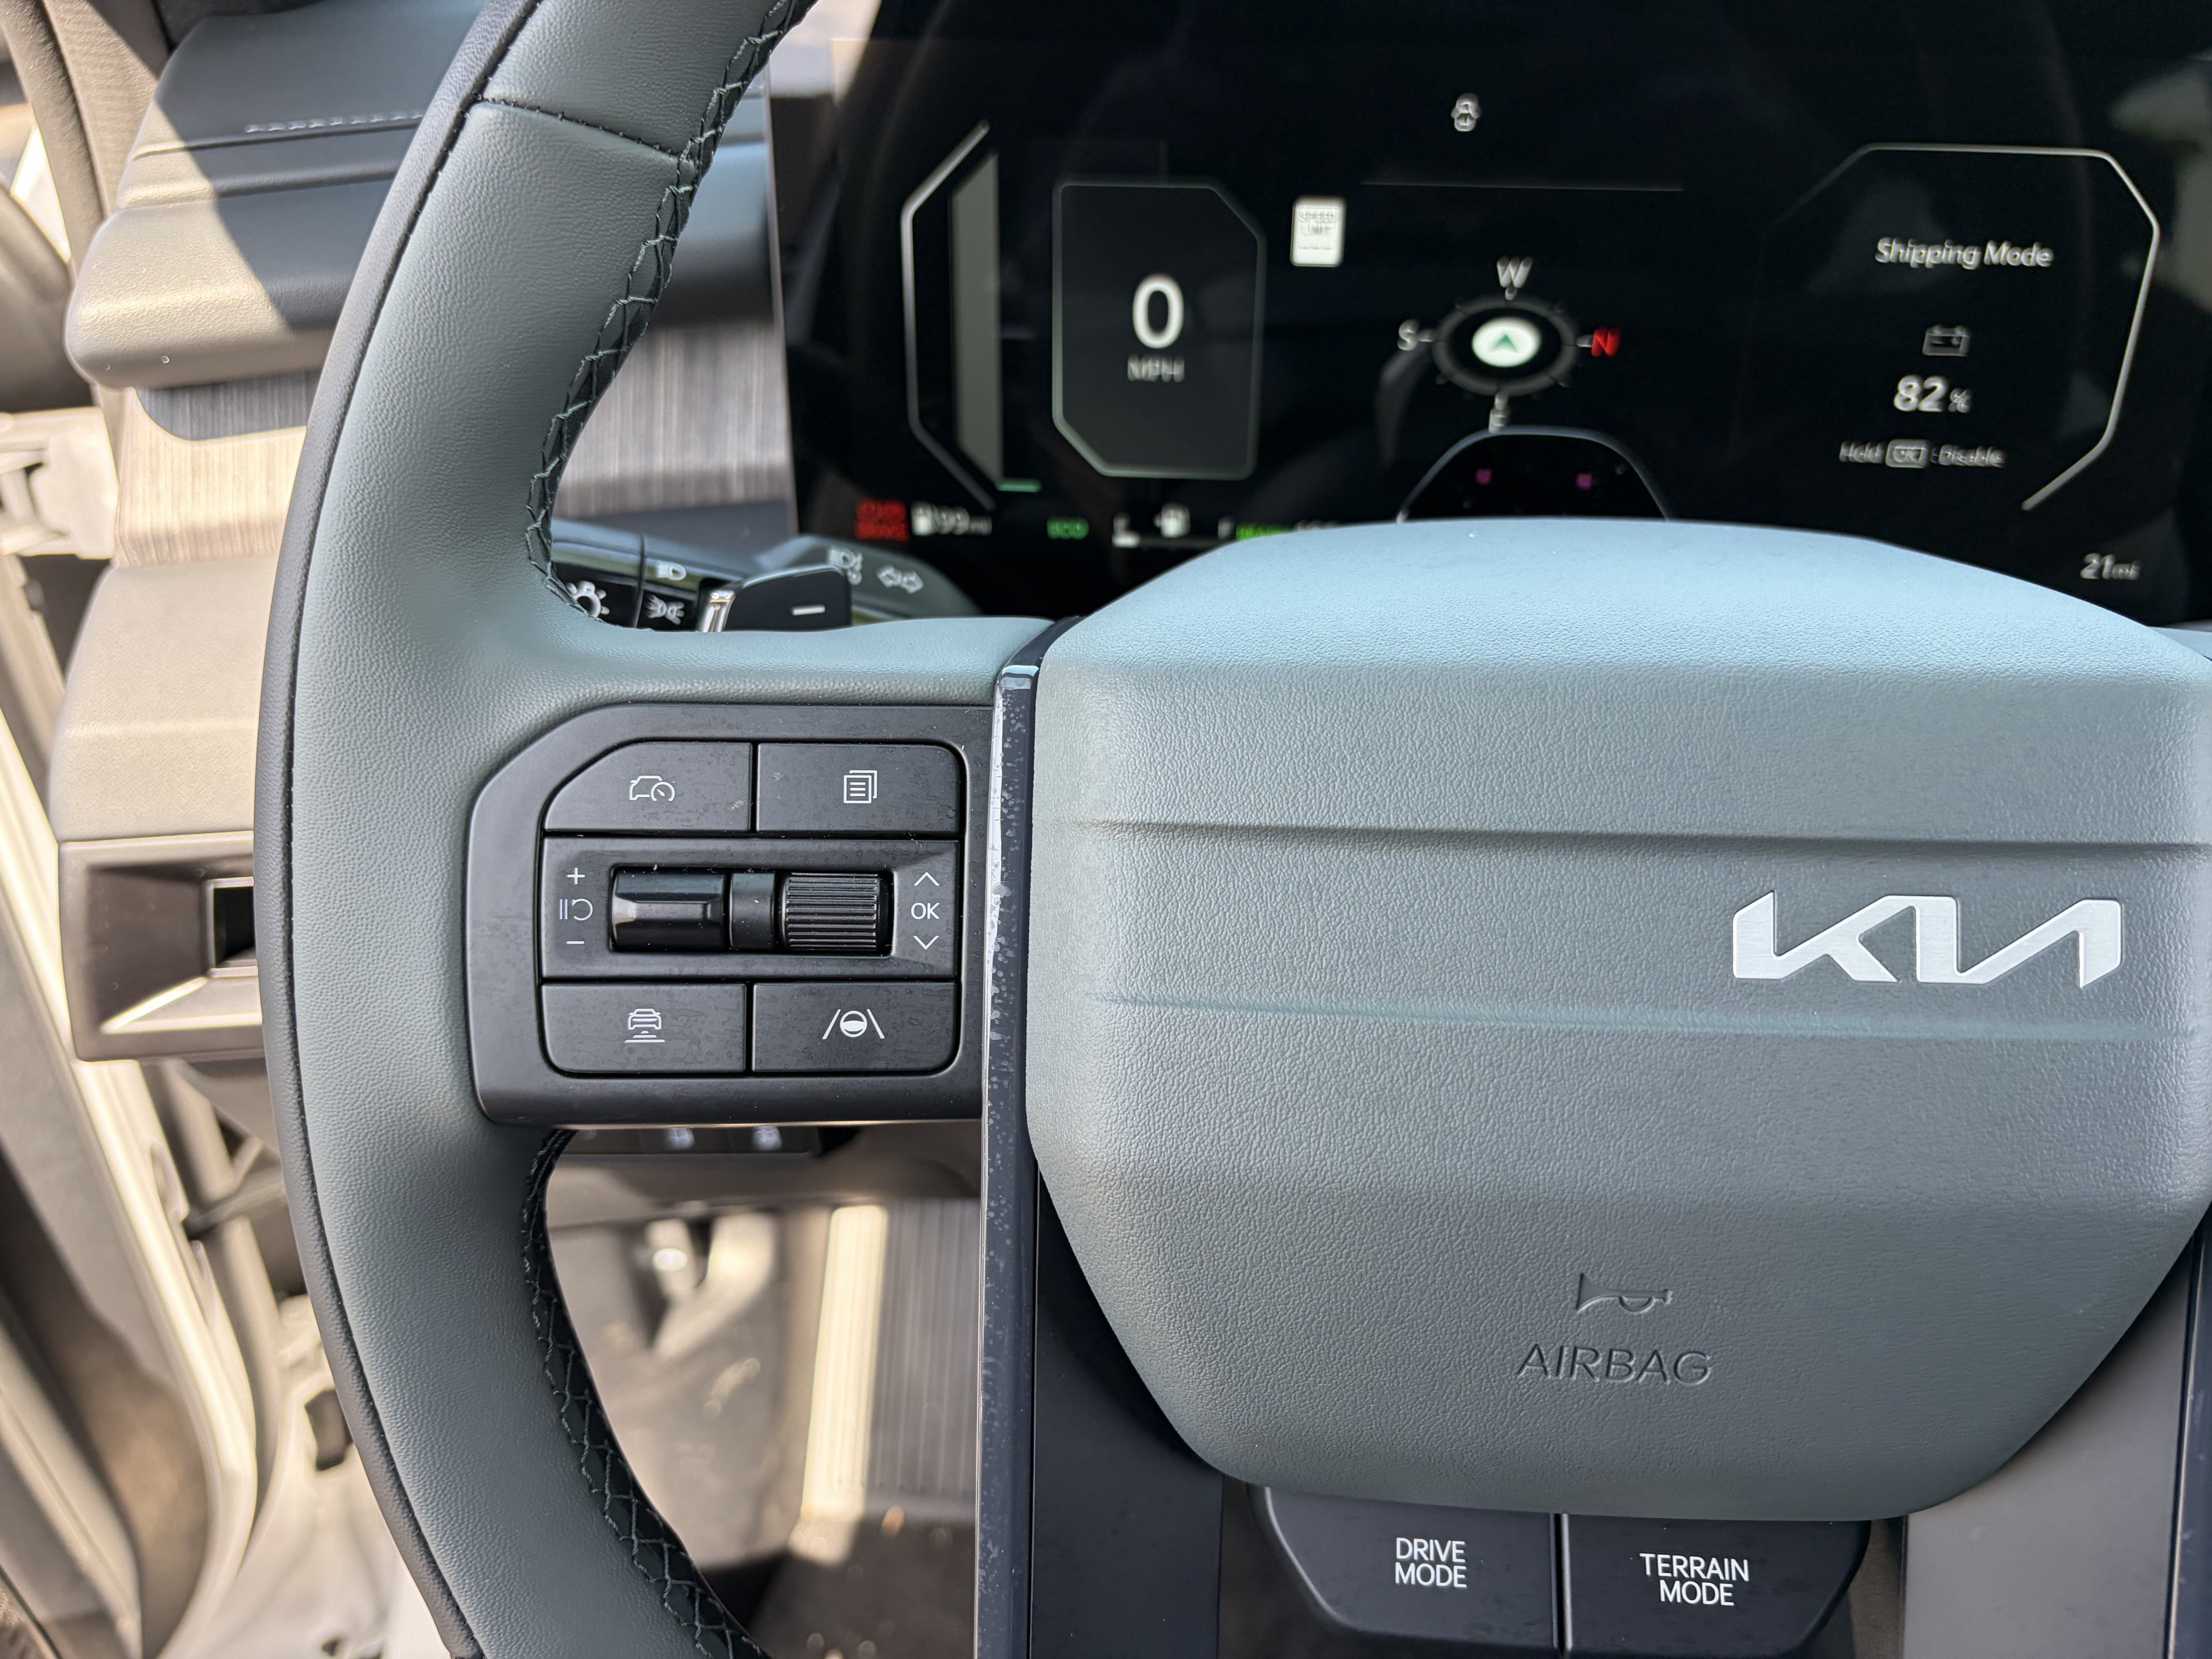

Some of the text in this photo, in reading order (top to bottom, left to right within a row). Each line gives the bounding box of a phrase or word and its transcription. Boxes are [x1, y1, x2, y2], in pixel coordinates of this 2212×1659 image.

[1875, 237, 2054, 270] Shipping Mode
[1496, 256, 1533, 288] W
[1132, 273, 1184, 349] 0
[1397, 319, 1419, 351] S
[1591, 327, 1621, 357] N
[1127, 355, 1185, 382] MPH
[1839, 441, 1885, 463] Hold
[911, 902, 940, 920] OK
[1733, 891, 2123, 988] KIA
[1516, 1343, 1712, 1386] AIRBAG
[1395, 1537, 1466, 1563] DRIVE
[1395, 1562, 1467, 1588] MODE
[1639, 1553, 1749, 1582] TERRAIN
[1659, 1580, 1735, 1606] MODE
